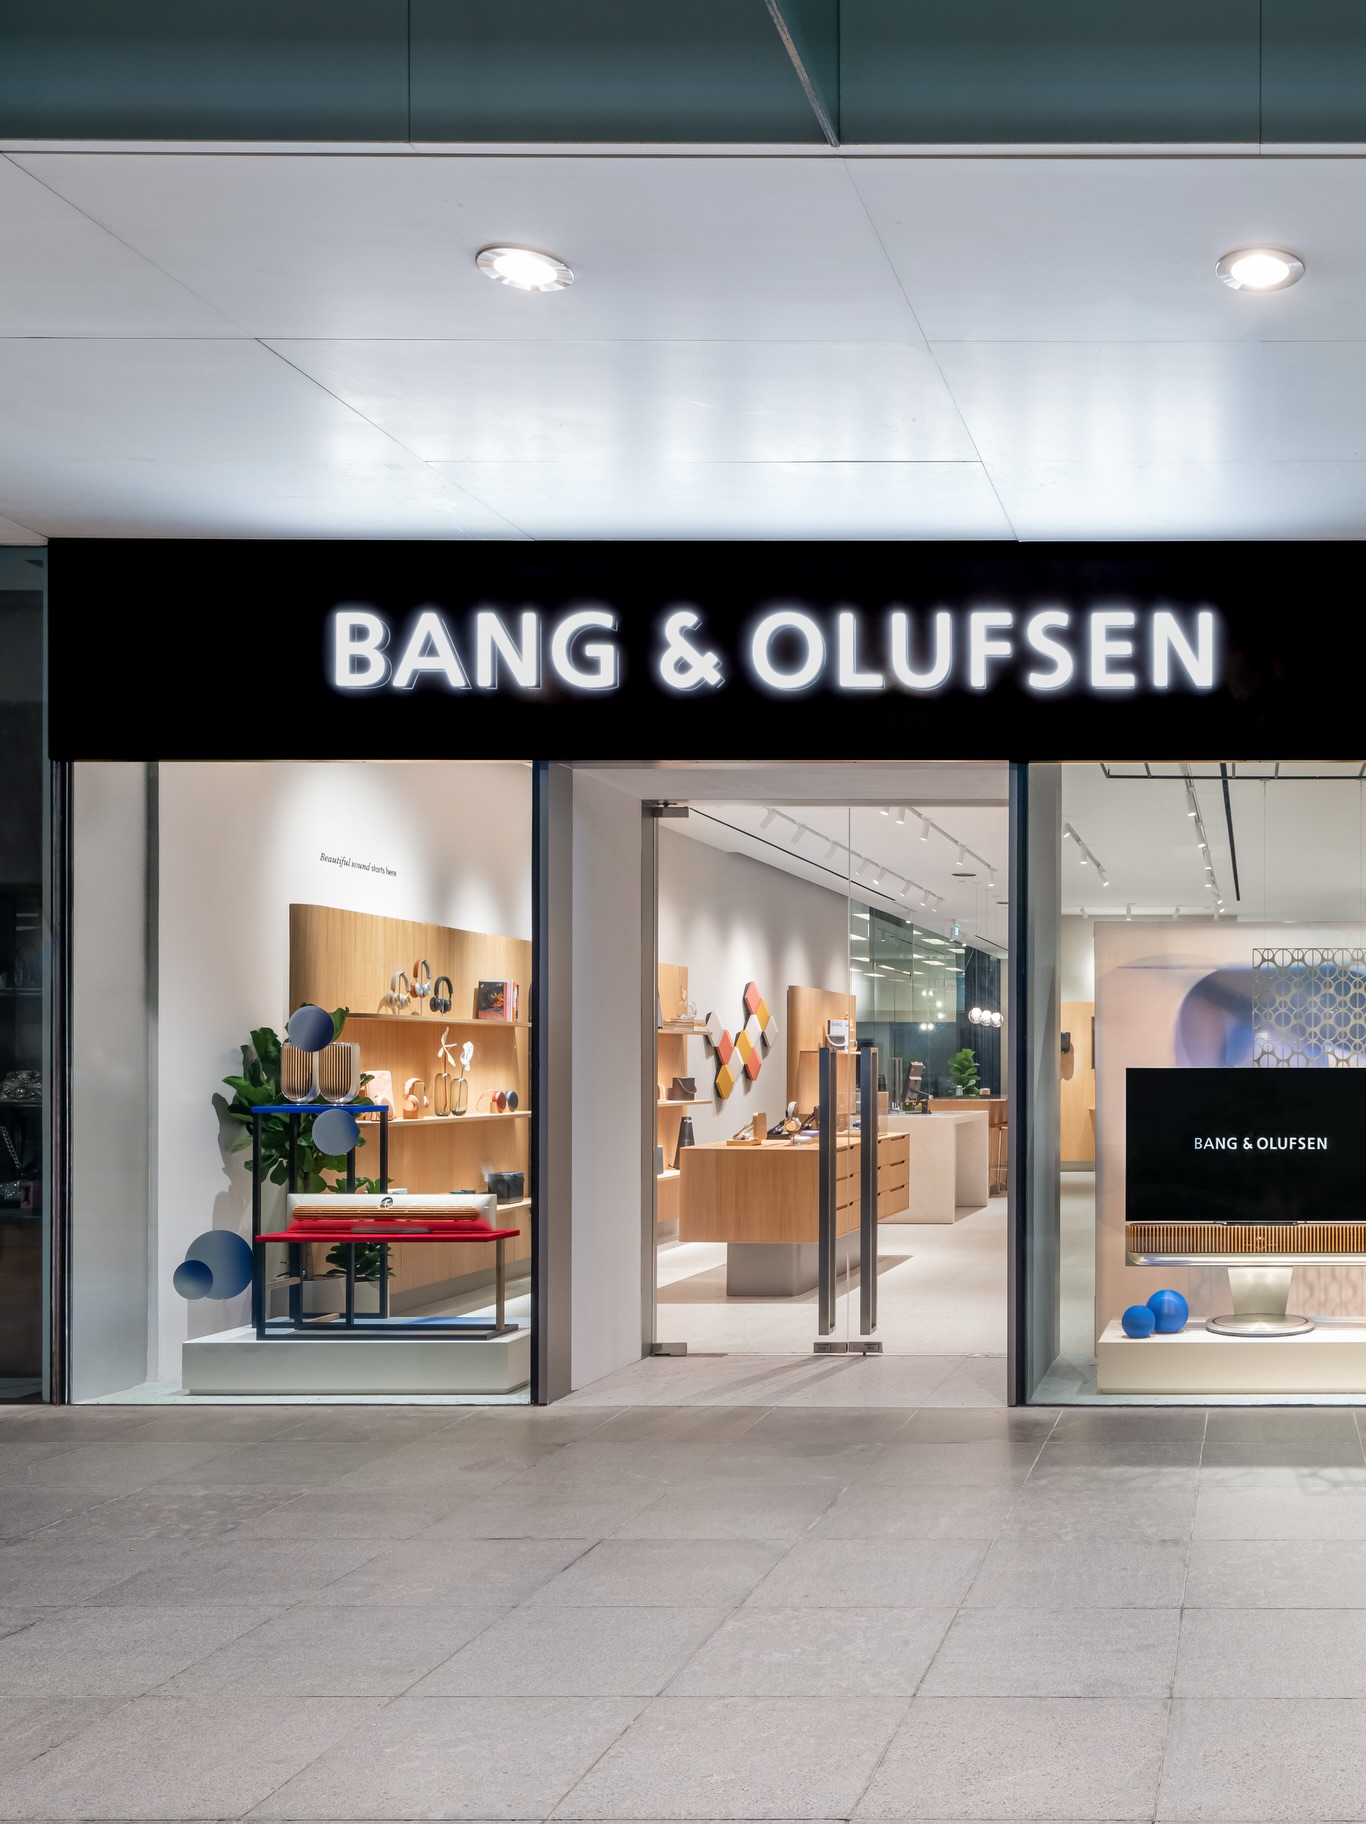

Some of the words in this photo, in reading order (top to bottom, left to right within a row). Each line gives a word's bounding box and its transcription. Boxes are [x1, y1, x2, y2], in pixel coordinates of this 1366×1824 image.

[335, 612, 619, 689] BANG
[659, 611, 724, 690] &
[752, 611, 1213, 690] OLUFSEN
[319, 852, 351, 868] Beautiful
[351, 862, 371, 871] sound
[371, 865, 385, 874] starts
[386, 866, 397, 877] here
[1194, 1137, 1238, 1150] BANG
[1242, 1137, 1254, 1150] &
[1256, 1137, 1328, 1150] OLUFSEN
